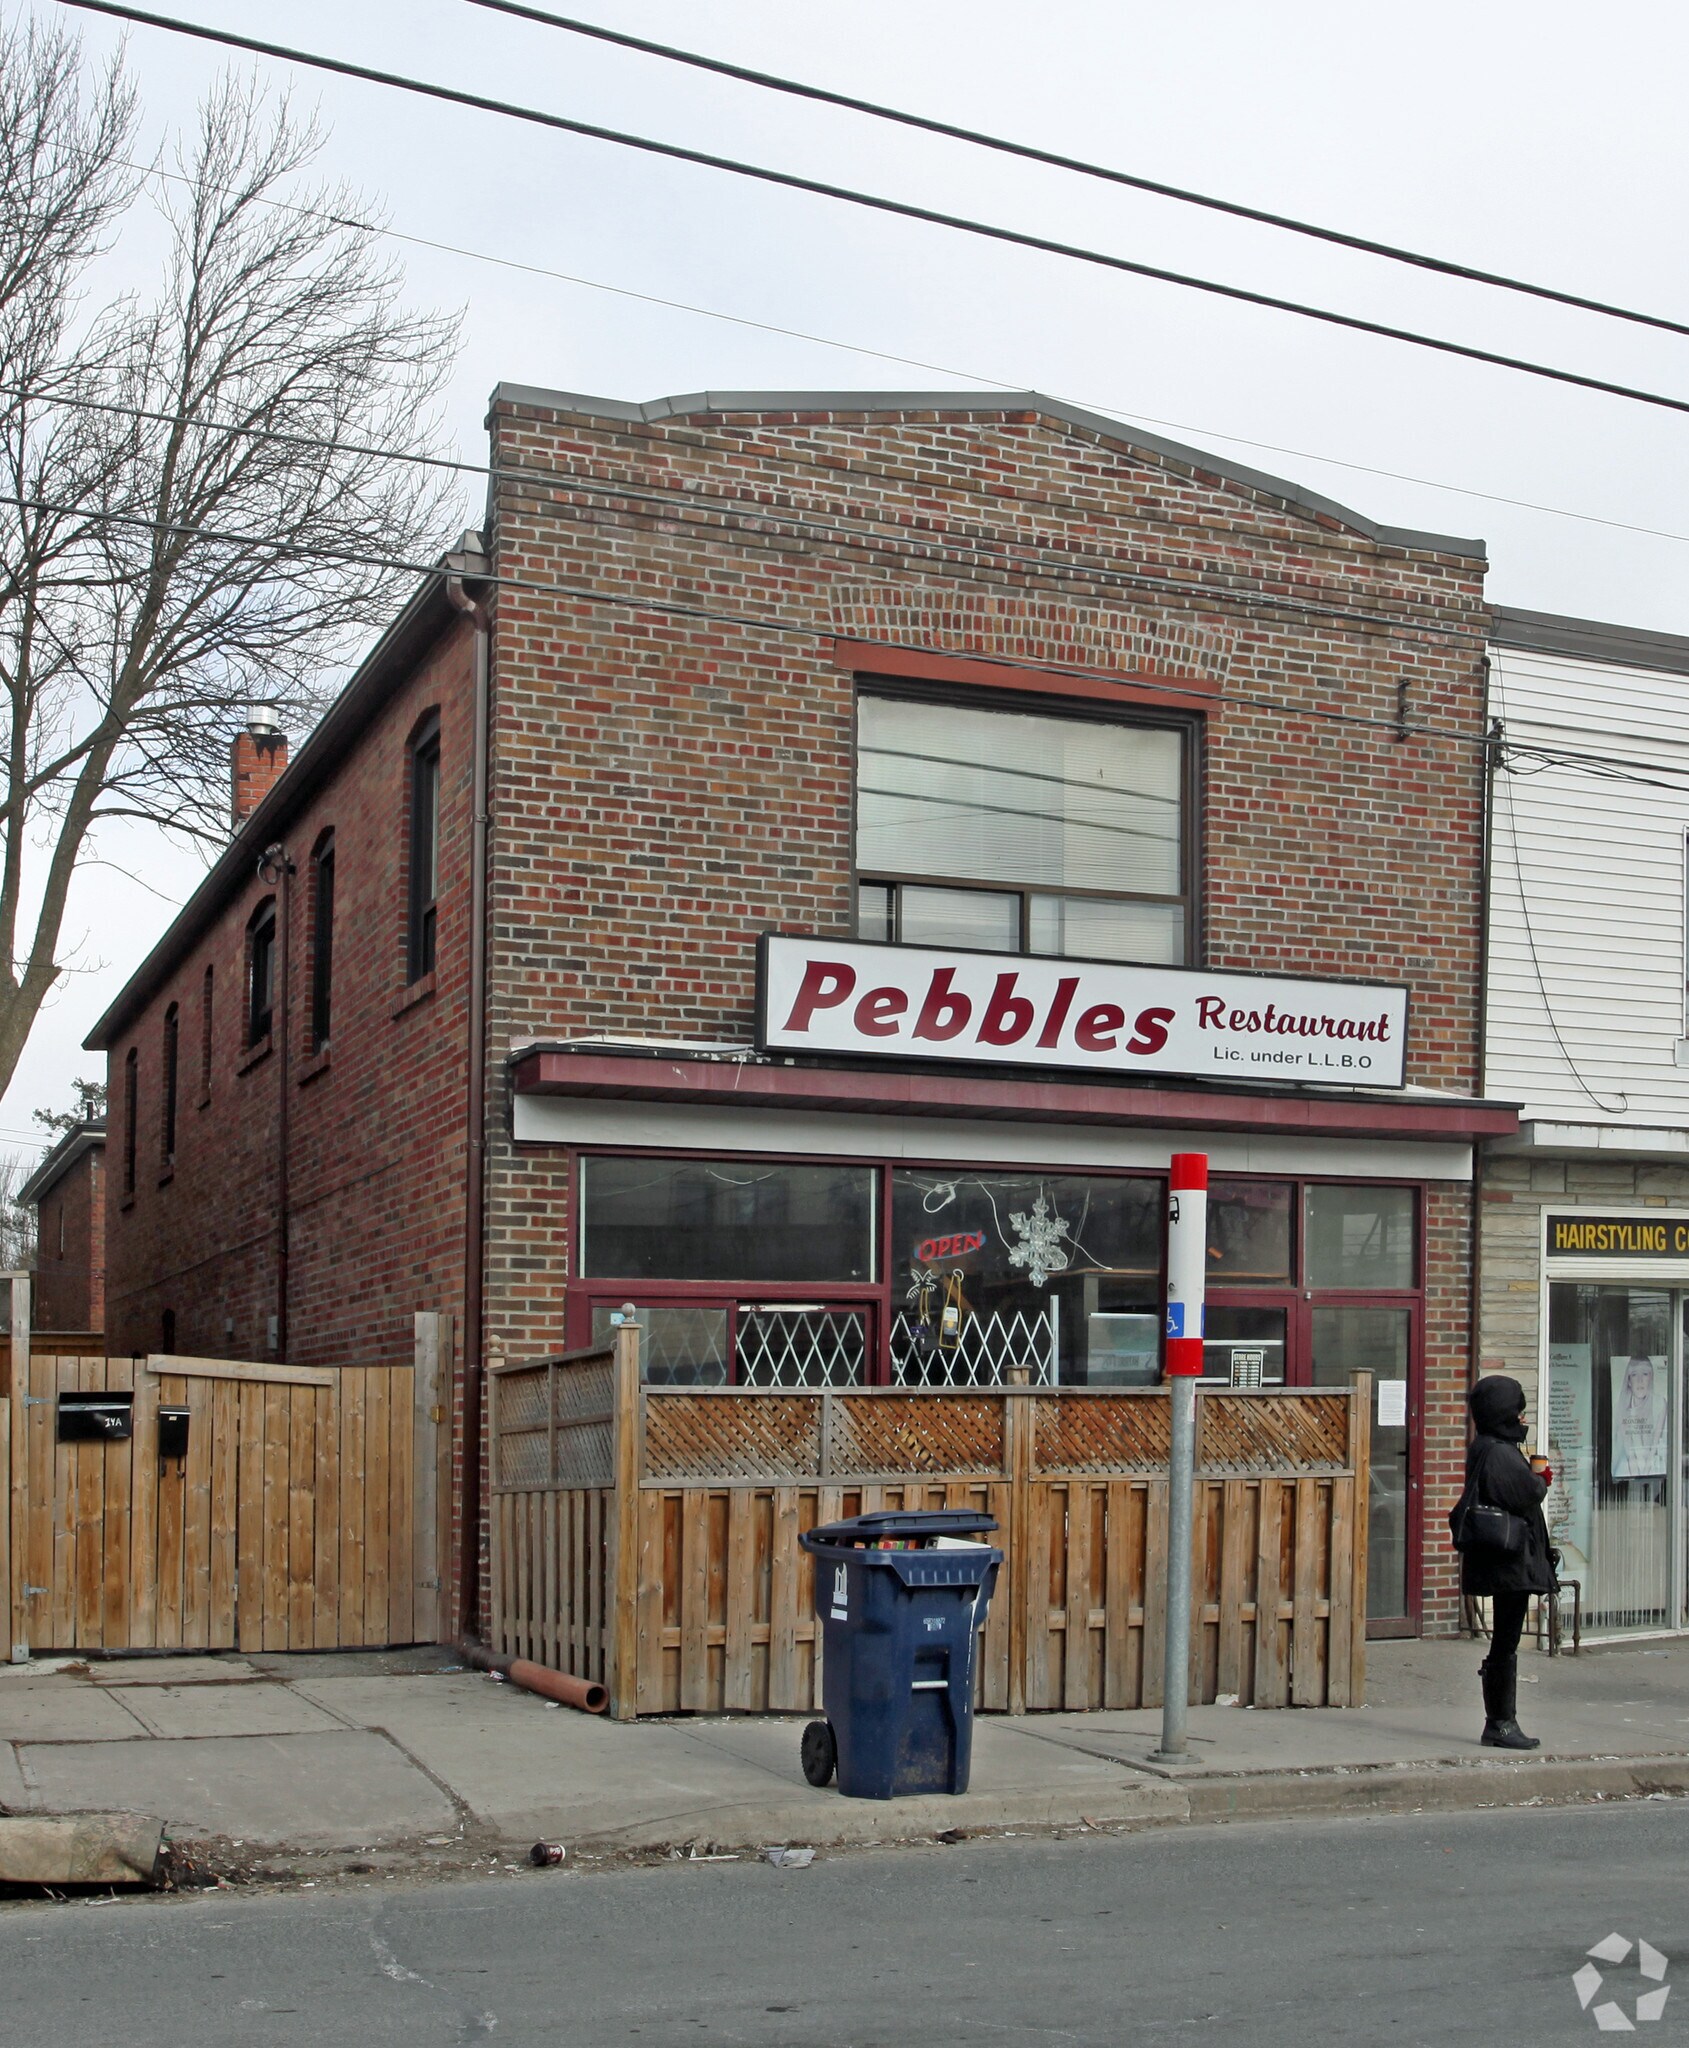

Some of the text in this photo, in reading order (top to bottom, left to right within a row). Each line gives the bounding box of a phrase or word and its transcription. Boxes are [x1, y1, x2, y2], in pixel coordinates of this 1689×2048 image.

[782, 960, 1391, 1055] Pebbles Restaurant
[1213, 1046, 1372, 1069] Lic. under L.L.B.O
[919, 1230, 983, 1262] OPEN
[1555, 1223, 1689, 1252] HAIRSTYLING C
